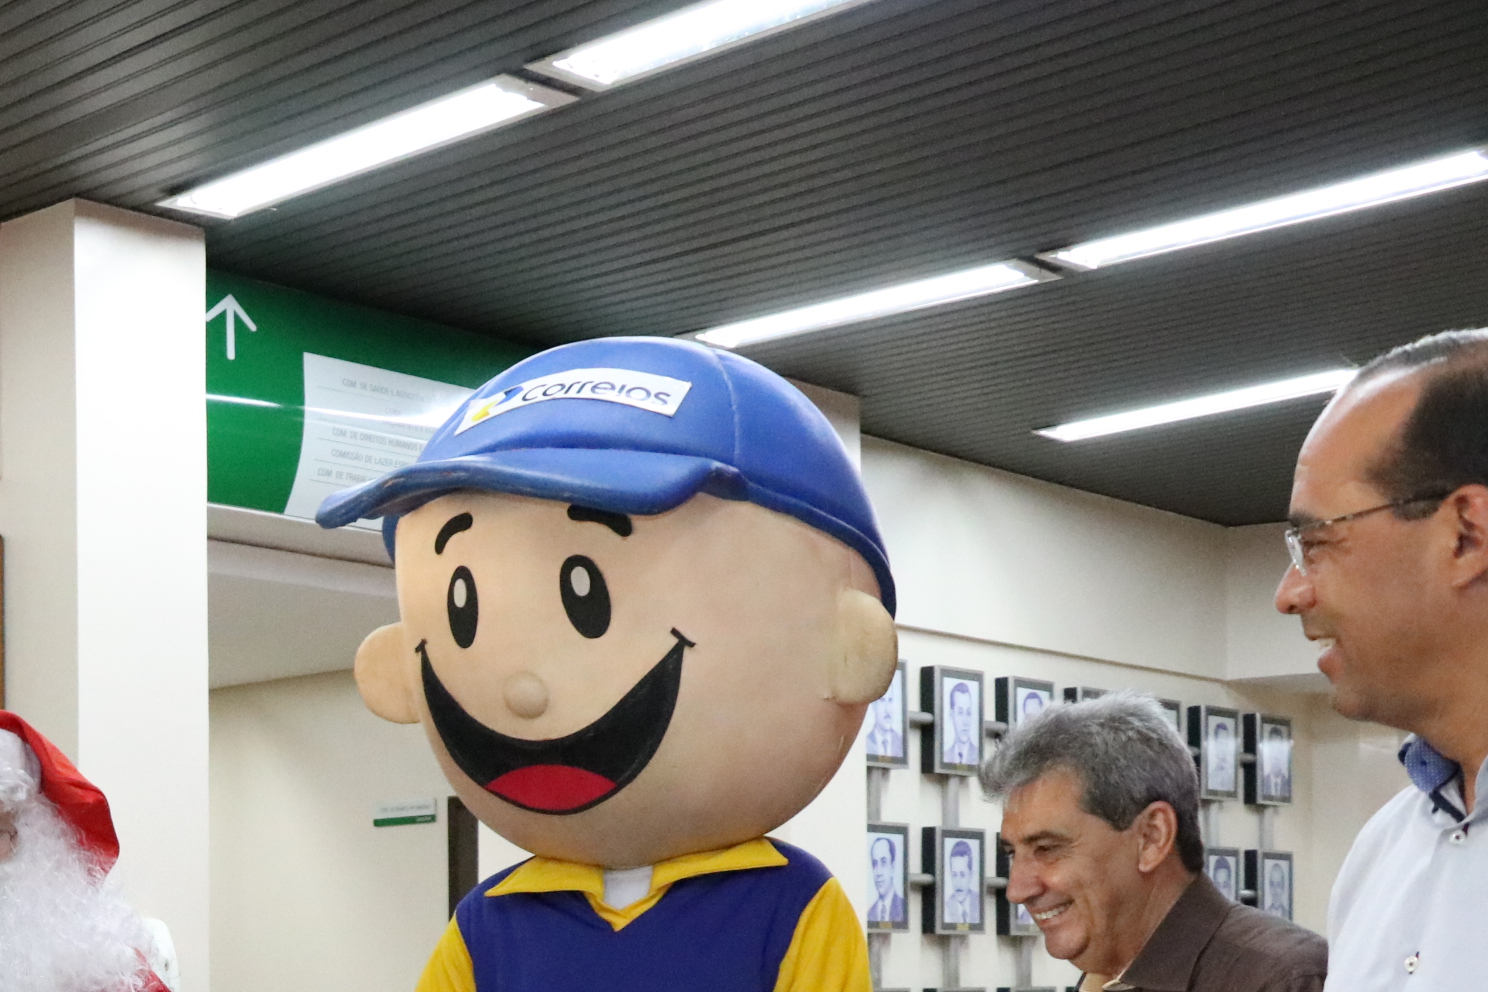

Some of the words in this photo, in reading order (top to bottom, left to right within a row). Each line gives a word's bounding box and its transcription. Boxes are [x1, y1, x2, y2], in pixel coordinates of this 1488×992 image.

[521, 381, 671, 406] Correios
[350, 431, 360, 440] DE
[360, 432, 387, 447] DIREITOS
[388, 439, 418, 452] HUMANOS
[332, 448, 363, 461] COMISSÃO
[365, 454, 373, 464] DE
[375, 456, 393, 468] LAZER
[335, 471, 345, 481] DE
